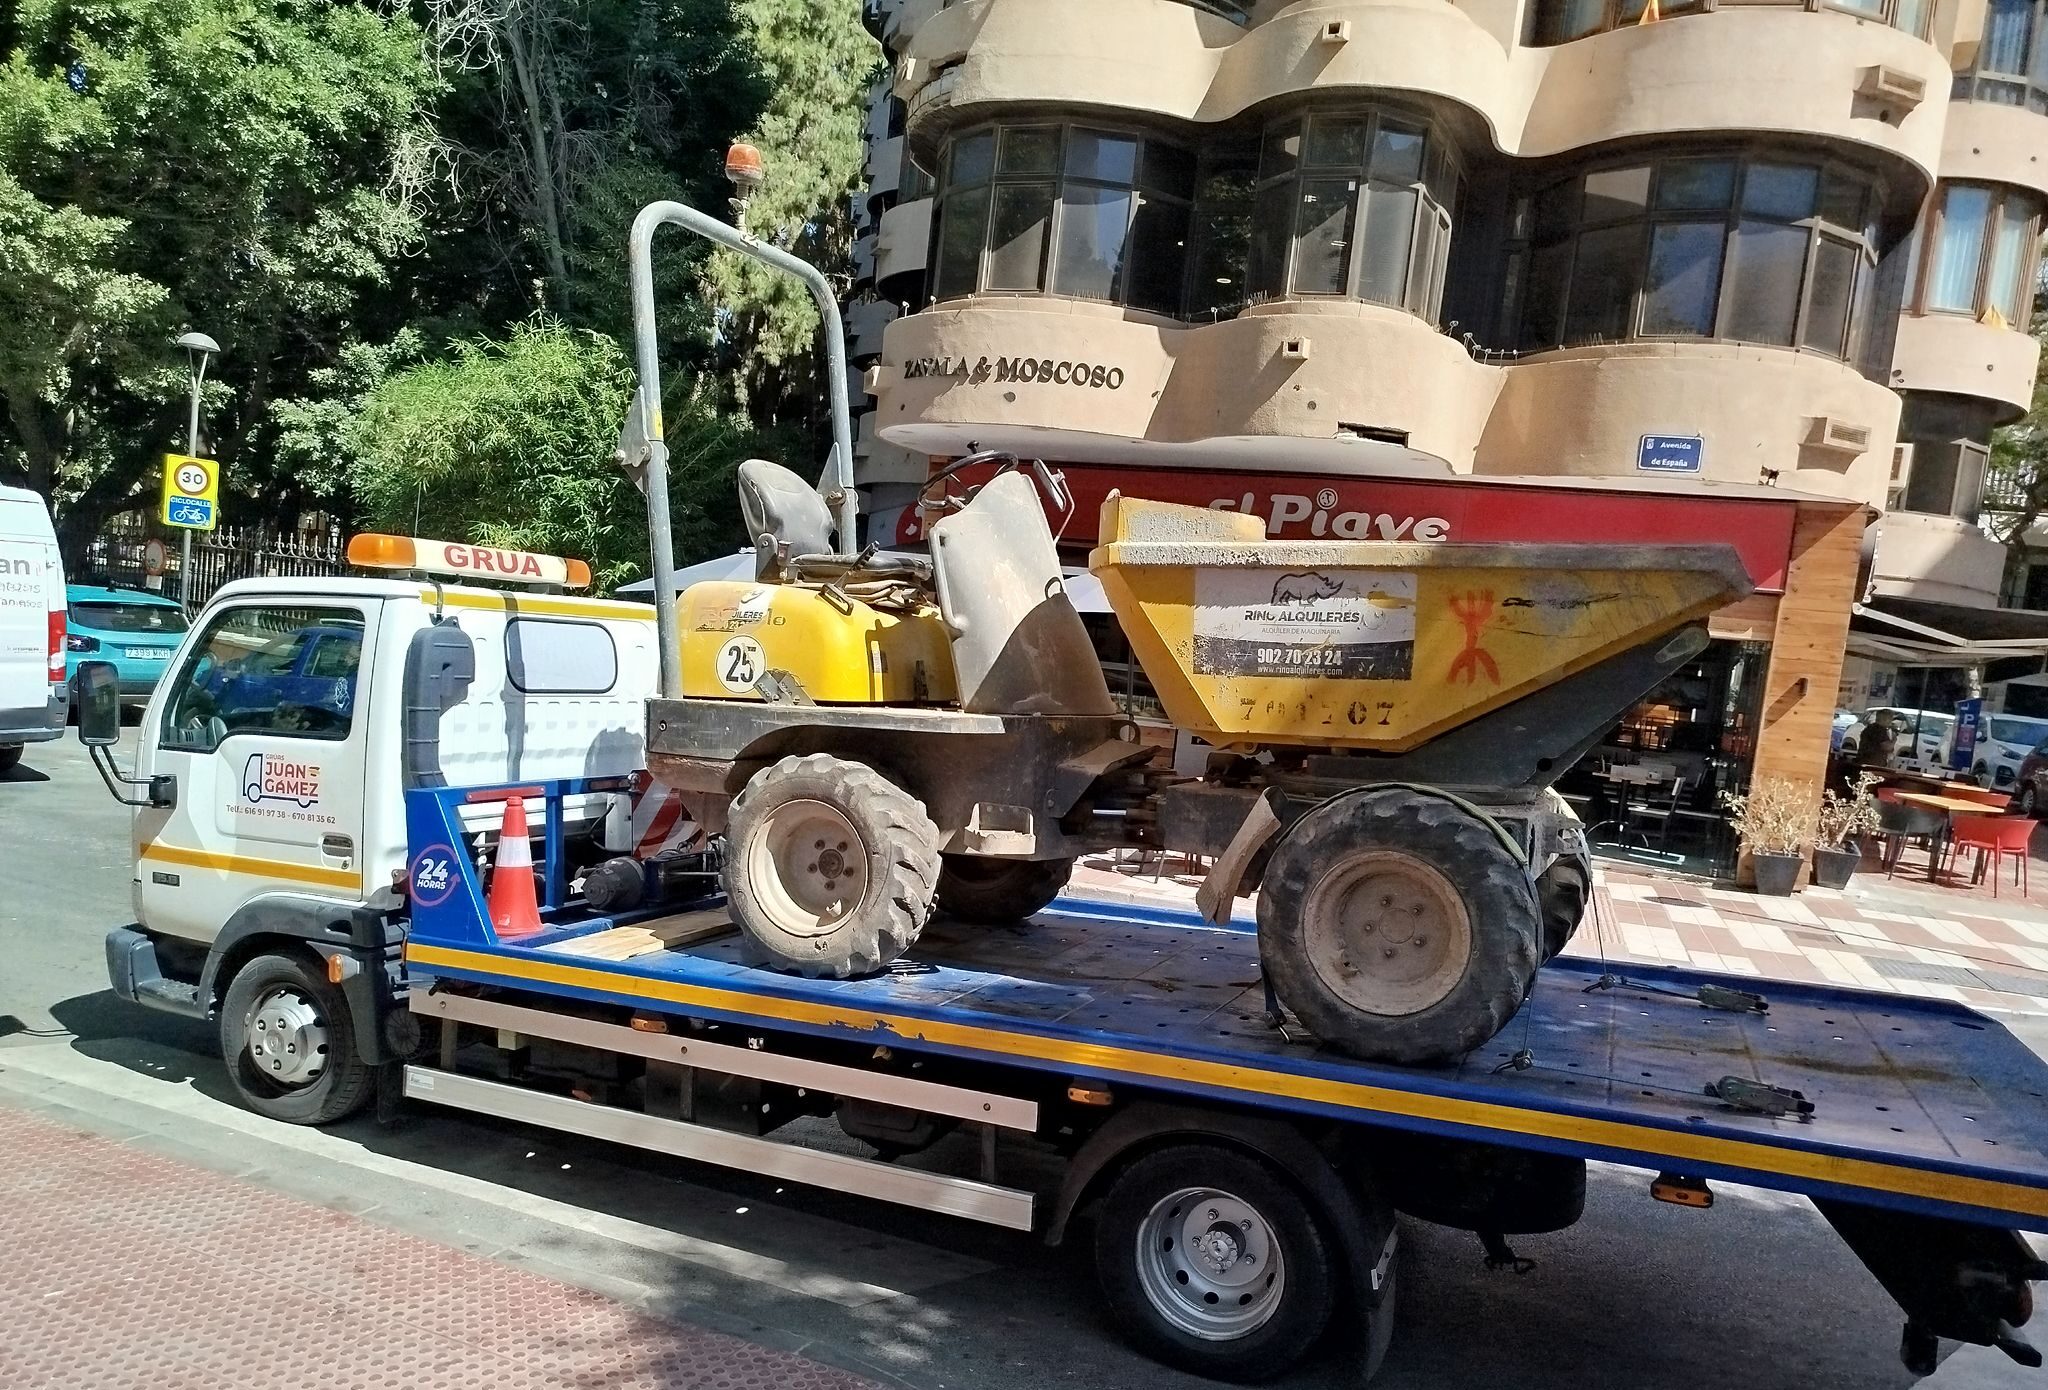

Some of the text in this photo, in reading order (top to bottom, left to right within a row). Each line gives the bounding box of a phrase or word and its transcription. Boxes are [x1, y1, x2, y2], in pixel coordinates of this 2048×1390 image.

[904, 356, 970, 379] ZAVALA
[994, 356, 1125, 390] MOSCOSO
[1662, 459, 1688, 467] España
[182, 472, 203, 485] 30
[170, 497, 211, 507] CICLOCALLE
[1267, 488, 1451, 542] Piave
[444, 544, 542, 577] GRUA
[1278, 611, 1360, 622] ALQUILERES
[1291, 627, 1299, 635] DE
[127, 648, 151, 657] 7399
[1257, 648, 1343, 666] 902 70 23 24
[725, 645, 756, 683] 25
[265, 762, 306, 778] JUAN
[265, 778, 319, 797] GÁMEZ
[257, 808, 265, 816] 91
[266, 809, 275, 817] 97
[276, 810, 286, 818] 38
[292, 812, 305, 820] 670
[326, 816, 336, 824] 62
[418, 858, 448, 881] 24
[417, 879, 446, 889] HORAS
